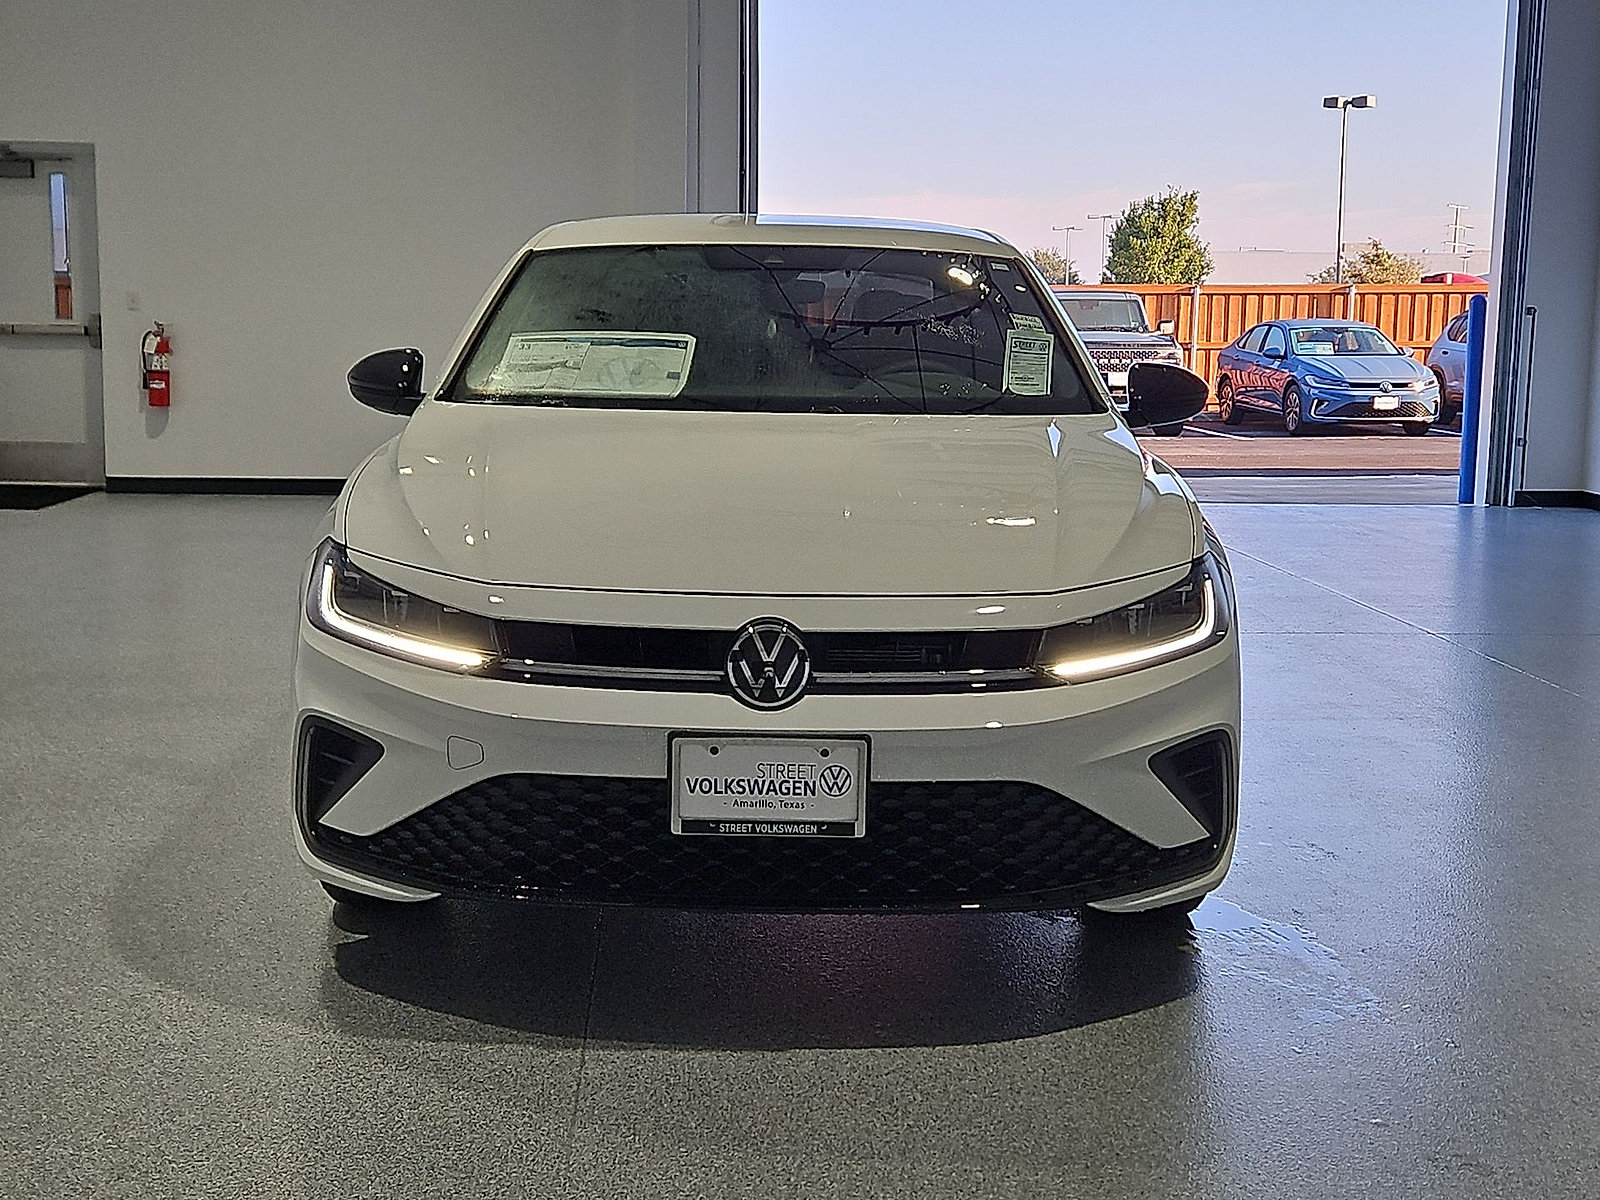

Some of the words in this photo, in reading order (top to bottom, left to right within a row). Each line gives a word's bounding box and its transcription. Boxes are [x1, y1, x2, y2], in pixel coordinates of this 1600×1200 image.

[756, 762, 817, 780] STREET
[685, 777, 817, 797] VOLKSWAGEN
[732, 799, 777, 810] Amarillo,
[779, 800, 805, 810] Texas
[719, 823, 753, 833] STREET
[755, 824, 818, 834] VOLKSWAGEN
